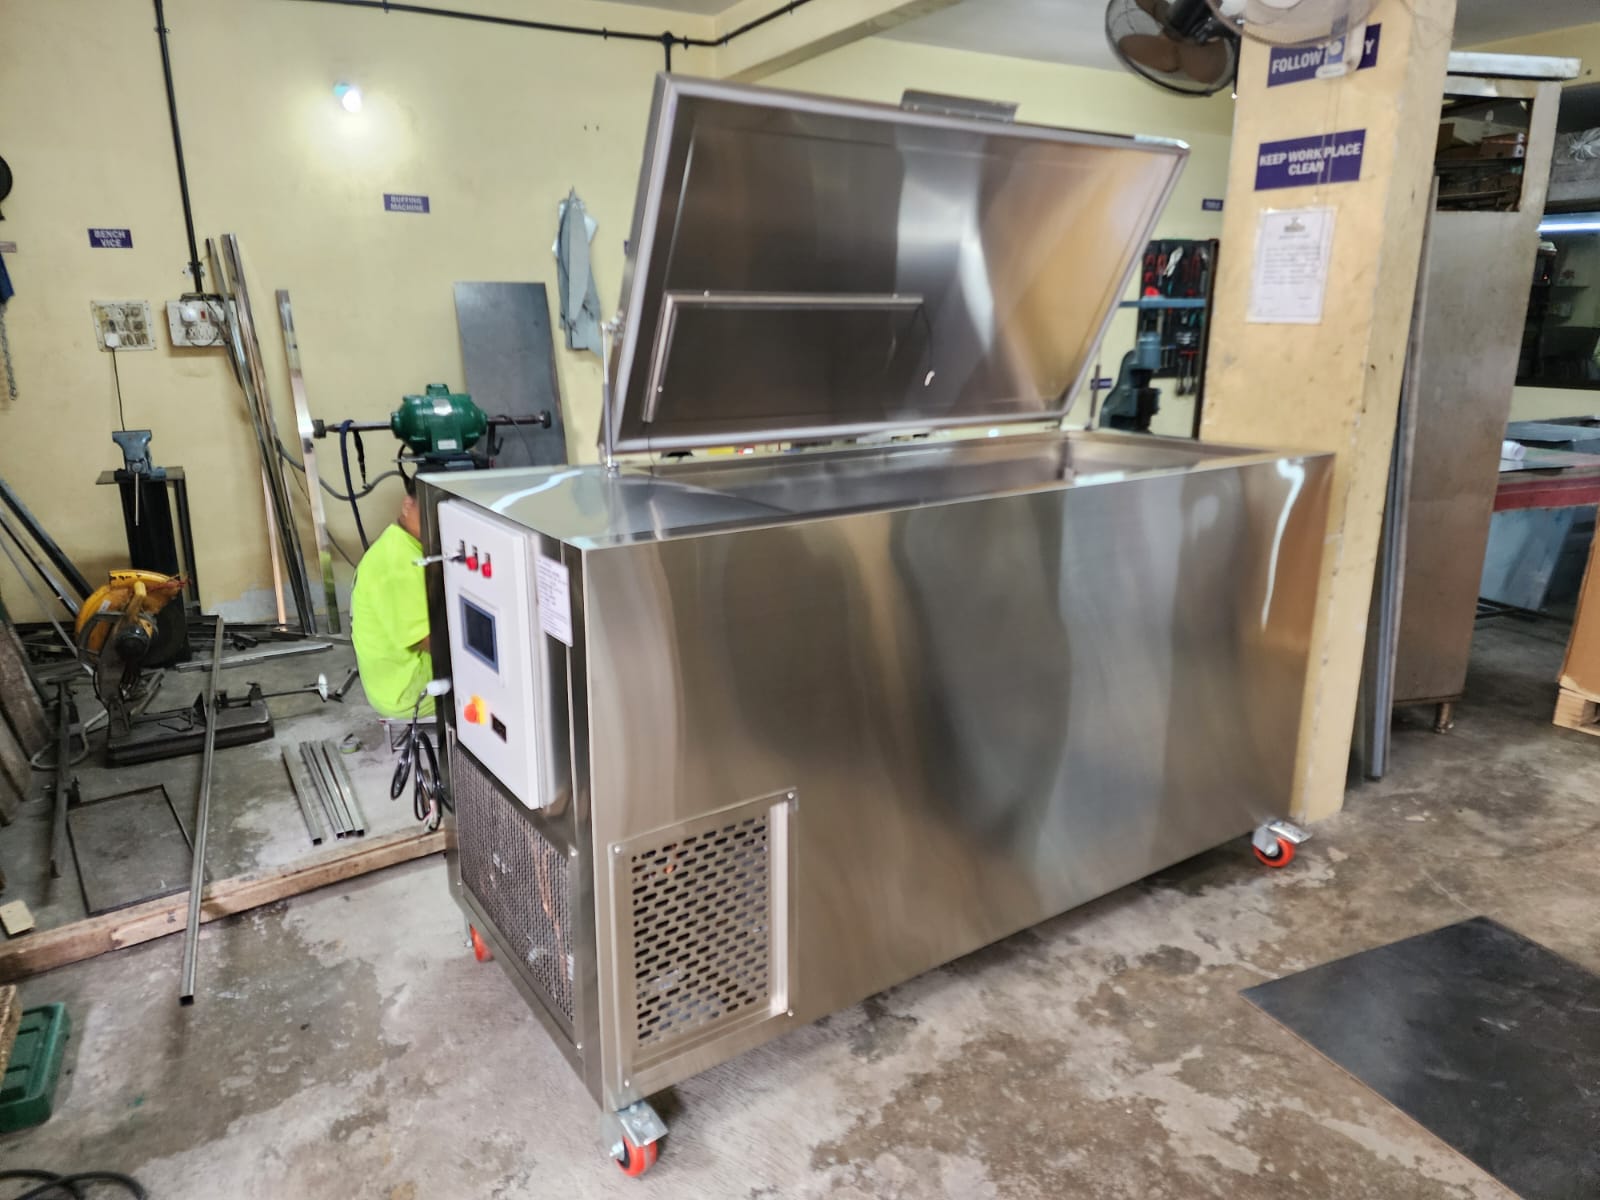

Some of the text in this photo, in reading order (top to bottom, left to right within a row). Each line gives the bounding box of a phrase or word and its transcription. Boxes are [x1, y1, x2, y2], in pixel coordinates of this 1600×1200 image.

[1271, 50, 1323, 74] FOLLOW
[1259, 143, 1361, 166] KEEP WORK PLACE
[1287, 160, 1324, 176] CLEAN
[390, 203, 423, 211] MACHINE
[94, 230, 126, 238] BENCH
[101, 238, 121, 247] VICE
